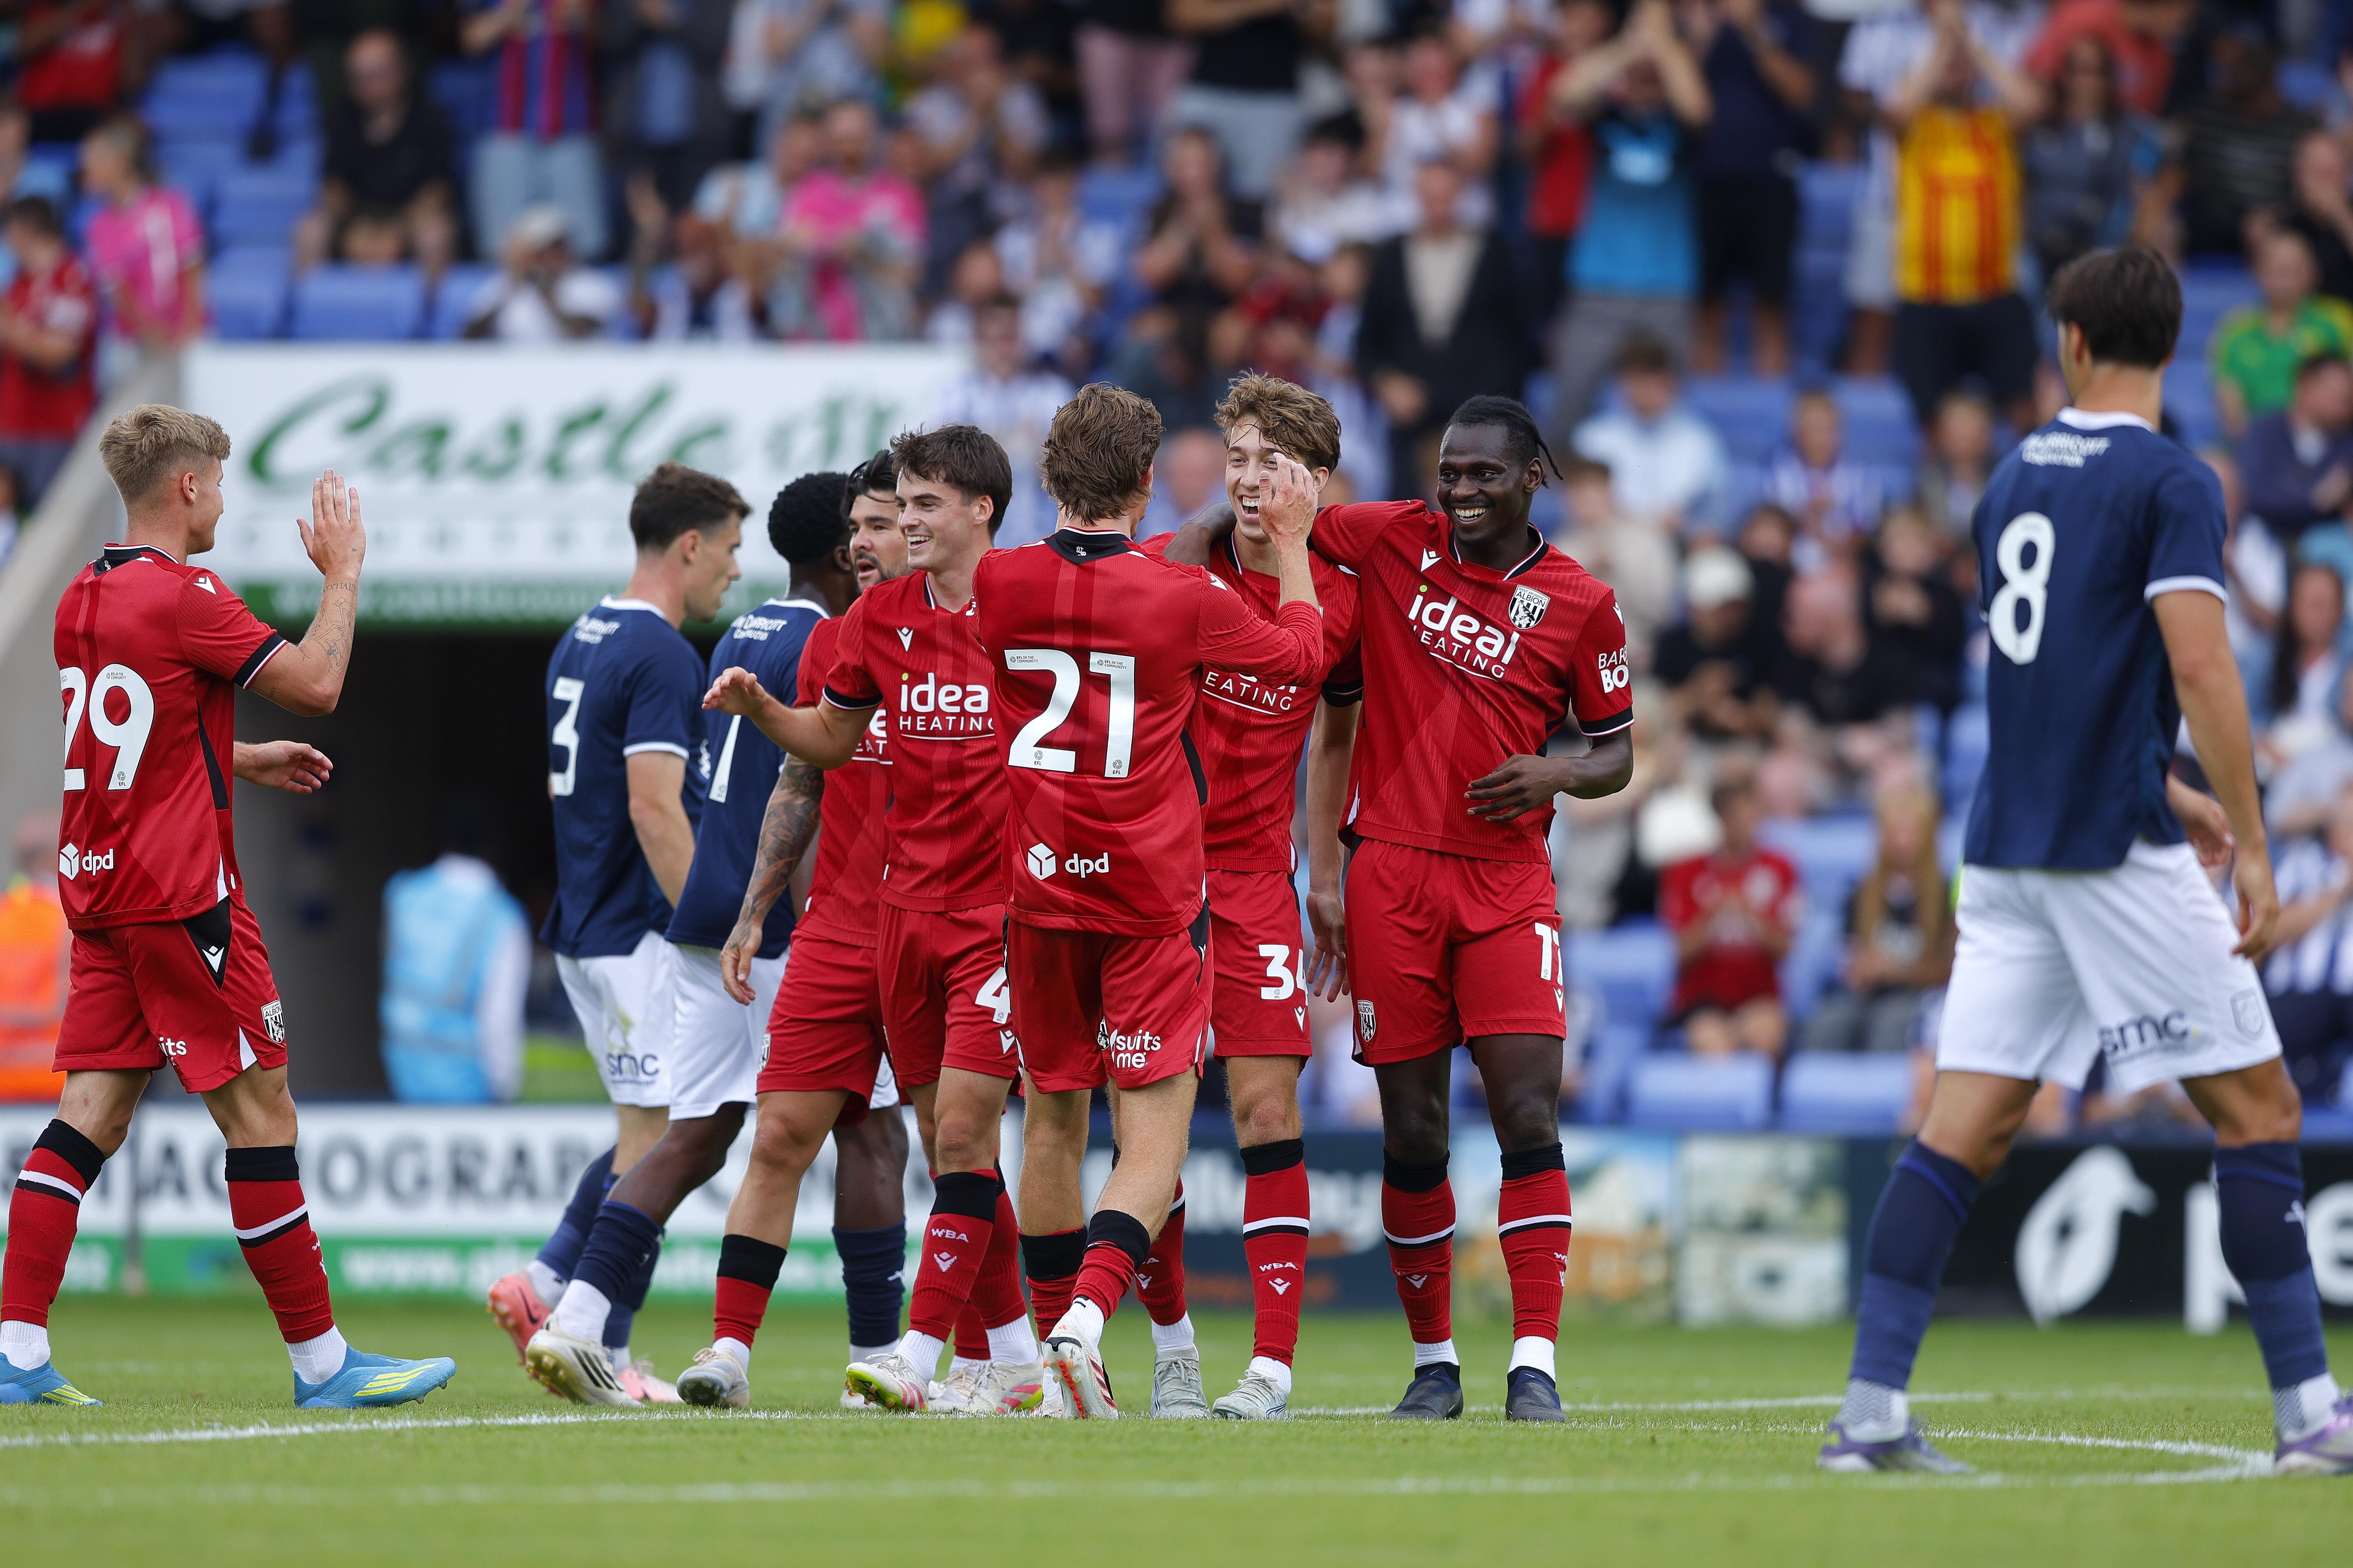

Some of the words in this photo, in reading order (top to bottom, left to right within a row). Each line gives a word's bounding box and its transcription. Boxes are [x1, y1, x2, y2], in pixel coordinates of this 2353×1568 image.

[246, 374, 733, 487] Castle
[1516, 591, 1546, 607] ALBION
[1990, 511, 2055, 665] 8
[1408, 585, 1520, 665] ideal
[1413, 625, 1505, 678] EATING
[900, 672, 989, 714] idea
[1205, 671, 1293, 711] EATING
[59, 663, 155, 791] 29
[1004, 648, 1135, 779] 21
[551, 676, 586, 796] 3
[82, 848, 114, 876] dpd
[1065, 852, 1109, 878] dpd
[265, 1005, 282, 1018] ALBION
[975, 966, 1011, 1024] 4
[159, 1036, 187, 1056] its
[1116, 1029, 1161, 1051] suits
[2098, 1010, 2189, 1056] smc
[1116, 1052, 1146, 1068] me
[931, 1228, 969, 1243] WBA
[1259, 1261, 1298, 1272] WBA
